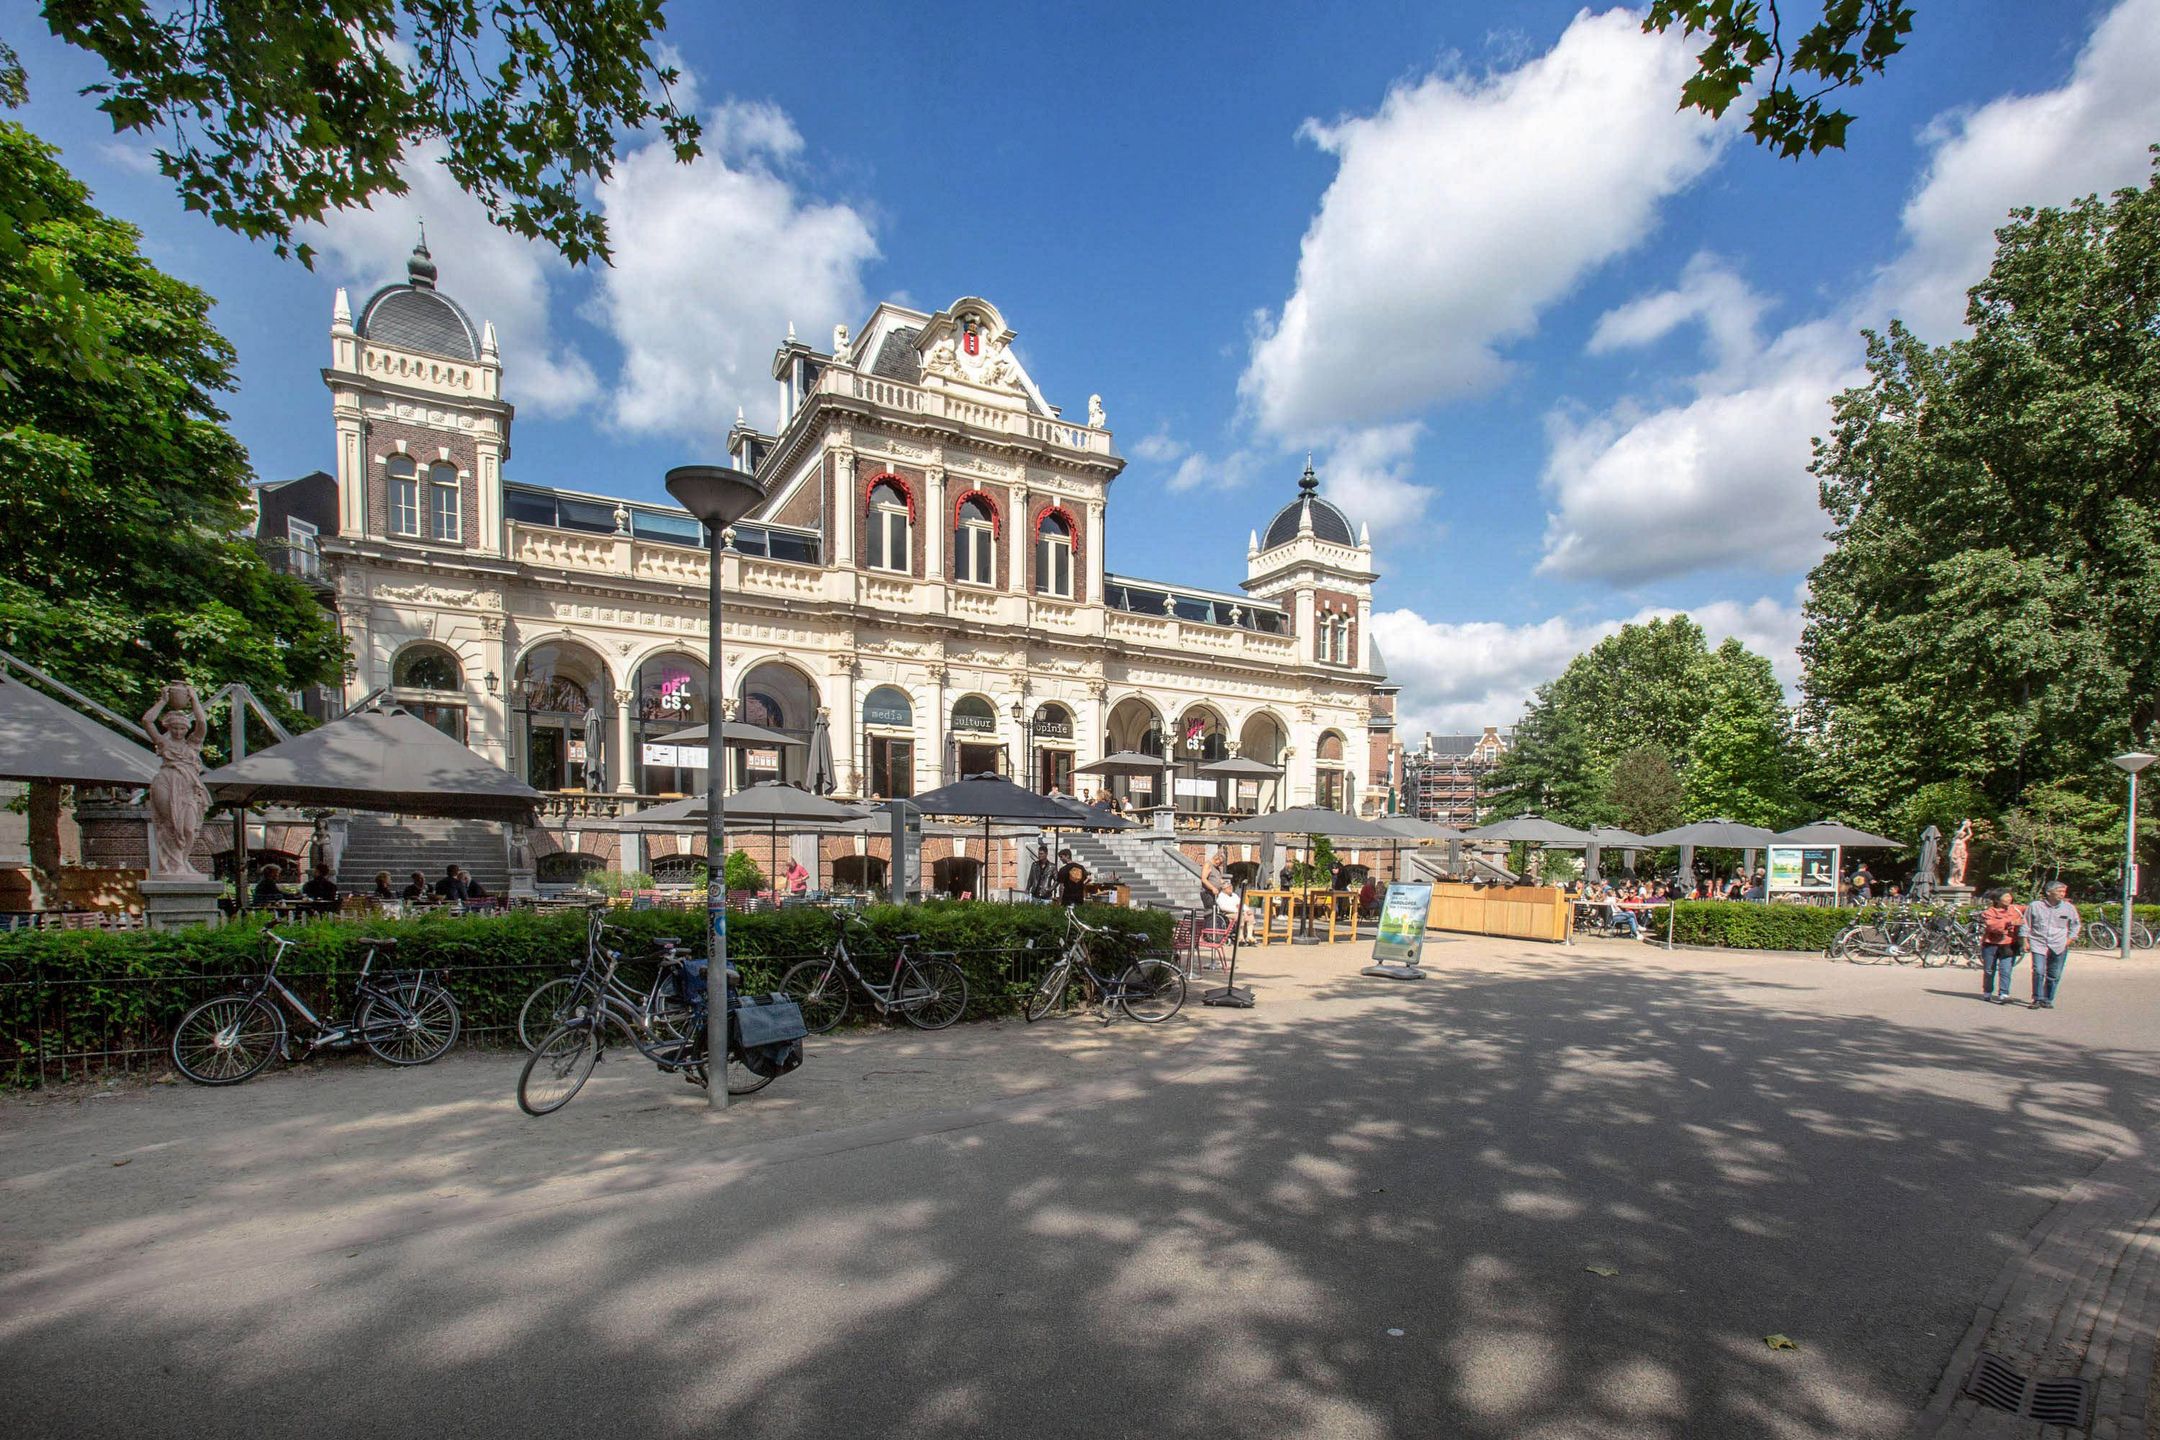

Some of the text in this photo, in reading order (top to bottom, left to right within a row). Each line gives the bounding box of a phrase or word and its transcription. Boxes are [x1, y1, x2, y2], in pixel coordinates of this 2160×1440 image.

[871, 709, 903, 721] media
[953, 717, 991, 728] cultuur
[1035, 722, 1068, 734] opinie
